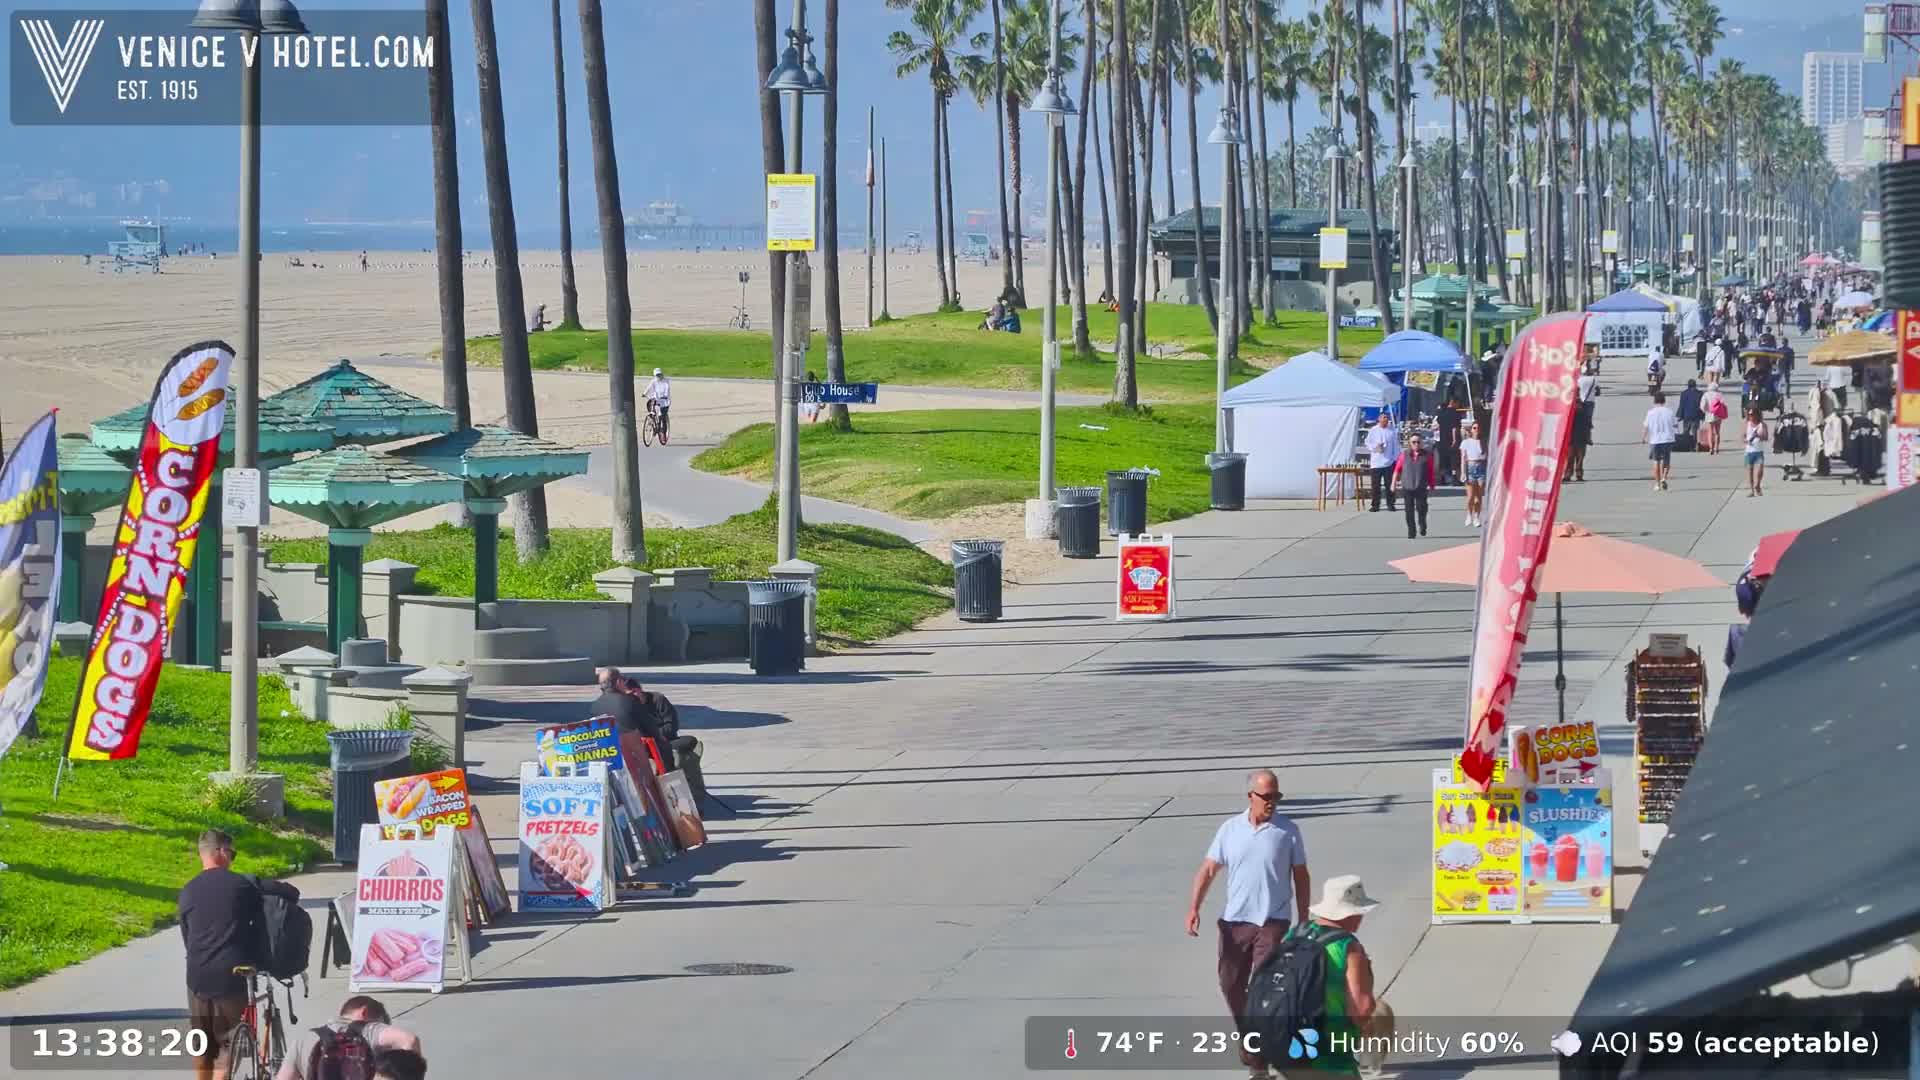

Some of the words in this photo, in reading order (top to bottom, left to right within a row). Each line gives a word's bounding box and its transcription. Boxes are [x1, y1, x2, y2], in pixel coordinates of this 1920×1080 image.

[830, 384, 860, 396] House
[123, 451, 195, 598] CORN
[87, 604, 158, 750] DOGS
[559, 728, 611, 744] CHOCOLATE
[1535, 721, 1594, 746] CORN
[558, 746, 618, 763] BANANAS
[1539, 739, 1599, 765] DOGS
[416, 801, 466, 817] WRAPPED
[526, 797, 601, 817] SOFT
[1529, 807, 1608, 824] SLUSHIES
[526, 820, 599, 837] PRETZELS
[360, 878, 444, 901] CHURROS
